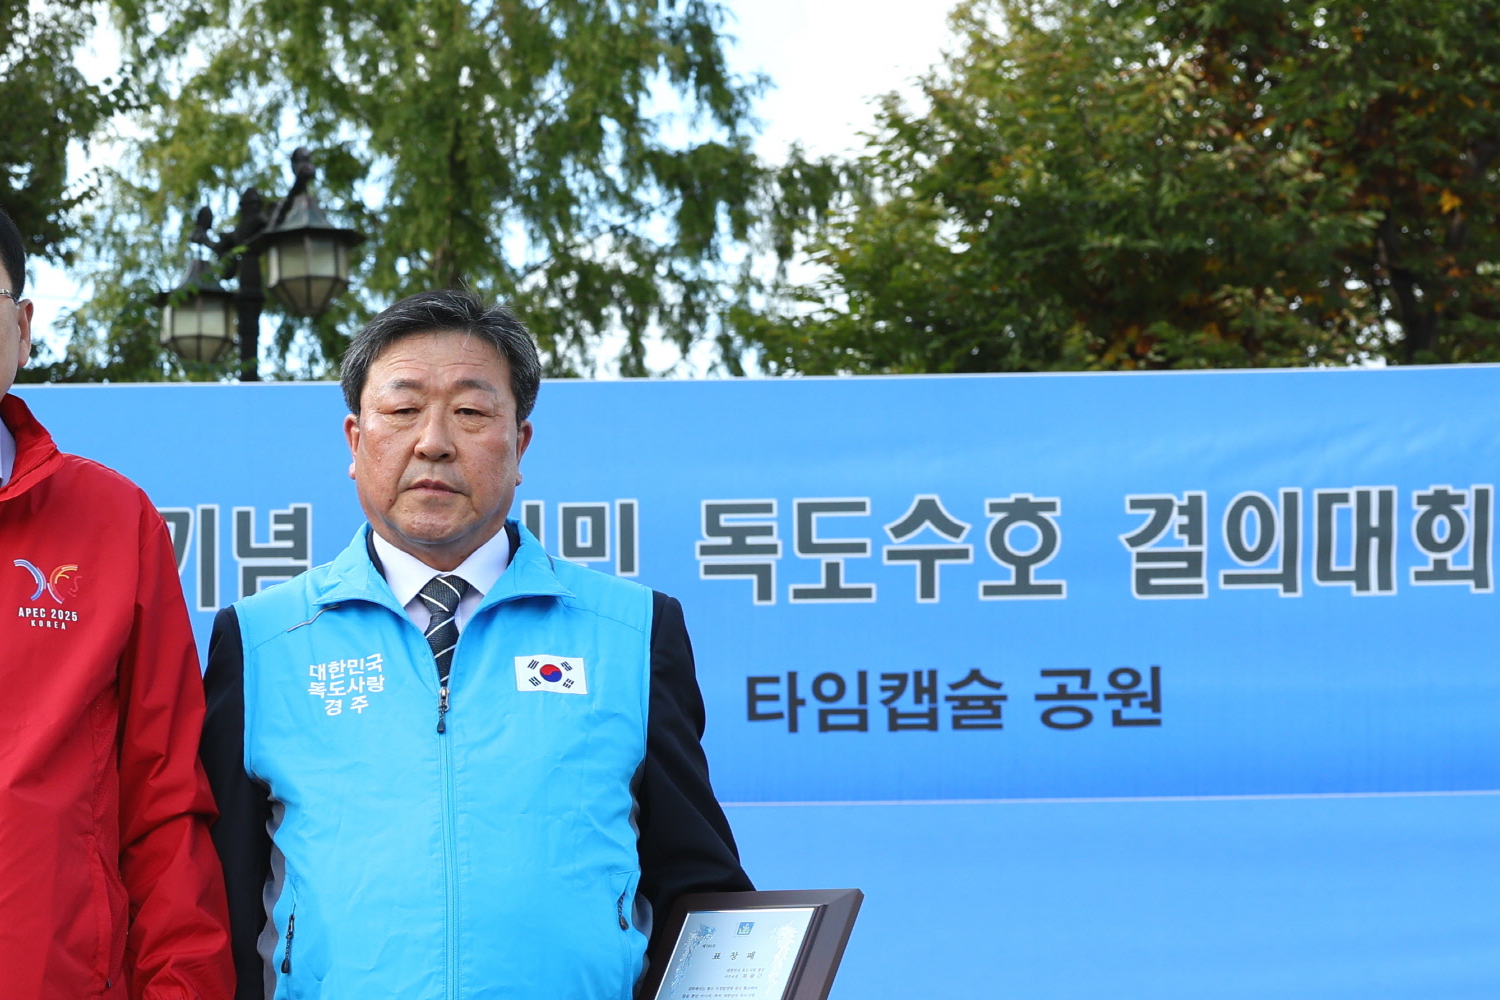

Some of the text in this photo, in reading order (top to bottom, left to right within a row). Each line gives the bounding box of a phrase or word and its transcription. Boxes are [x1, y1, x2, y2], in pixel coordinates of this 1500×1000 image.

[695, 494, 1067, 605] 독도수호
[1120, 485, 1495, 599] 결의대회
[18, 607, 78, 622] APEC 2025
[31, 620, 67, 630] KOREA
[309, 653, 384, 681] 대한민국
[307, 674, 385, 699] 독도사랑
[746, 665, 1164, 733] 타임캡슐 공원
